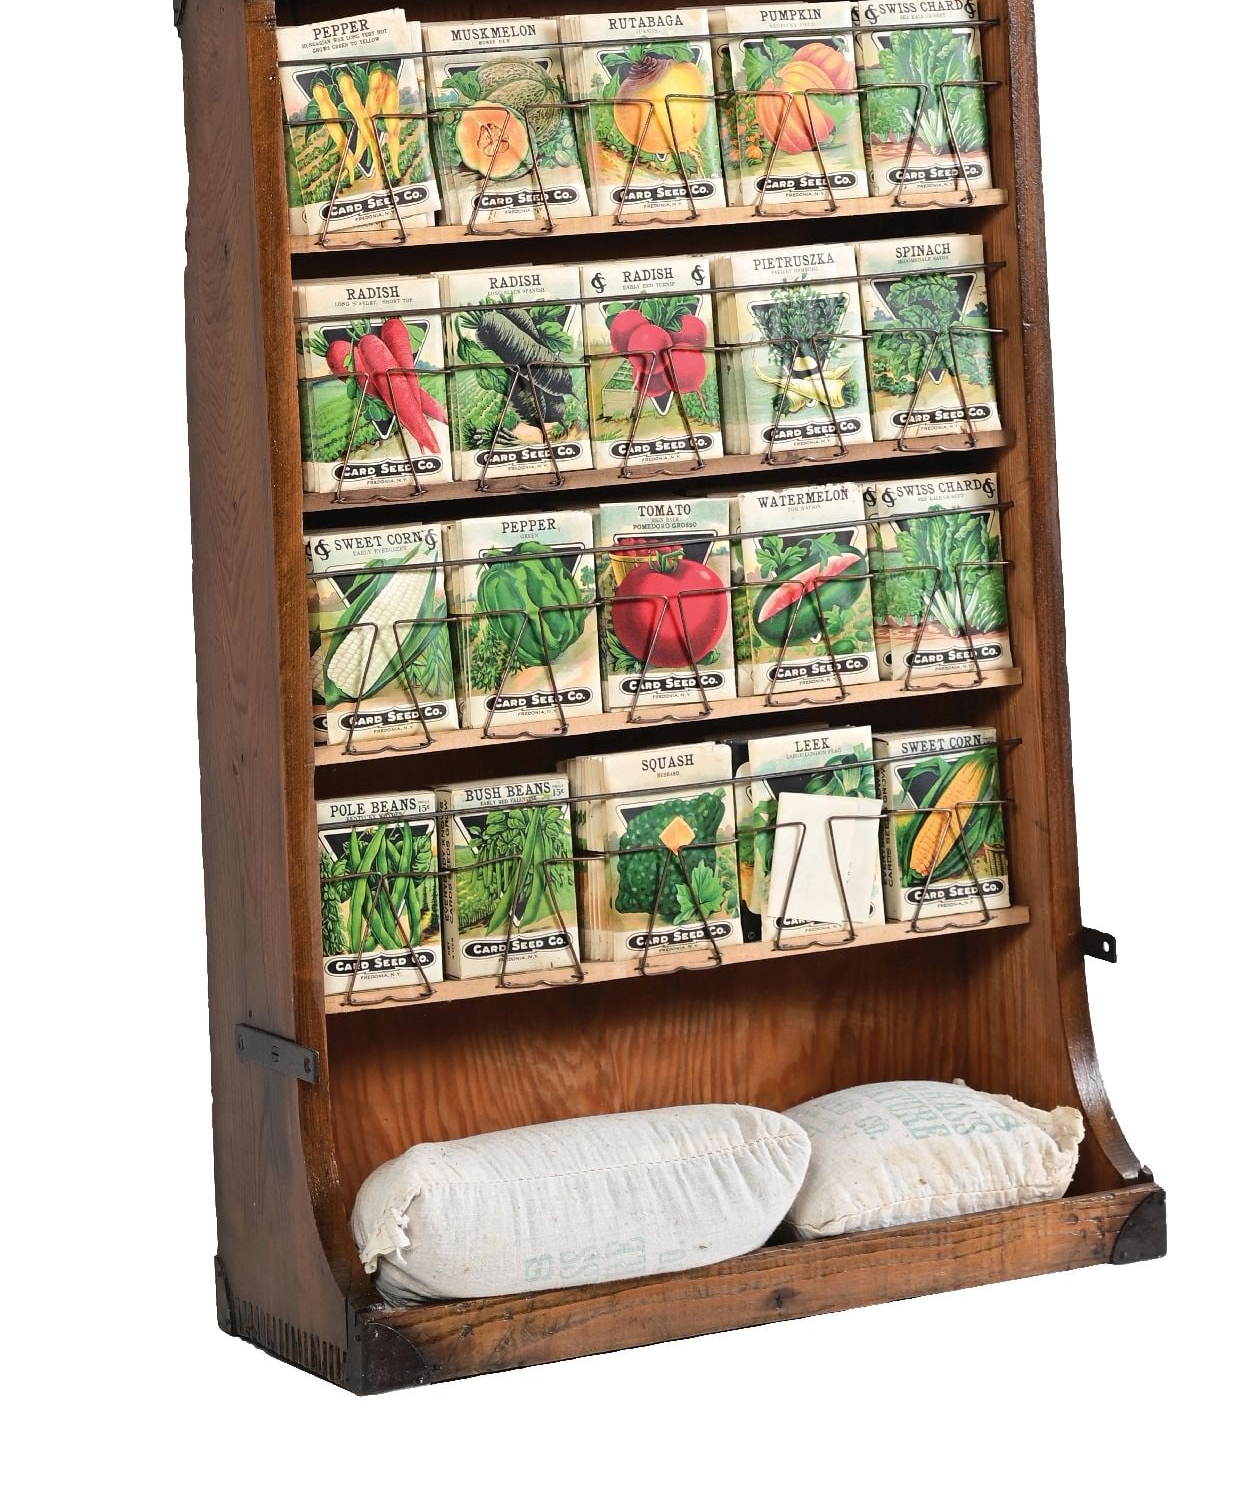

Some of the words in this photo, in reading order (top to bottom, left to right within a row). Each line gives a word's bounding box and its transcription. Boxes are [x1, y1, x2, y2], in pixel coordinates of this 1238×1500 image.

[878, 2, 916, 15] SWISS
[920, 0, 963, 12] CHARD
[608, 14, 684, 30] RUTABAGA
[760, 8, 822, 22] PUMPKIN
[312, 18, 370, 40] PEPPER
[451, 24, 536, 42] MUSKMELON
[833, 173, 851, 184] CO.
[931, 166, 962, 178] SEED
[403, 190, 423, 202] CO.
[553, 190, 572, 200] CO.
[656, 188, 689, 199] SEED
[690, 185, 709, 196] CO.
[895, 243, 952, 259] SPINACH
[753, 253, 835, 271] PIETRUSZKA
[622, 268, 673, 282] RADISH
[488, 275, 542, 290] RADISH
[345, 286, 400, 300] RADISH
[934, 410, 966, 421] SEED
[968, 408, 986, 419] CO.
[806, 425, 836, 435] SEED
[839, 422, 857, 433] CO.
[556, 446, 576, 457] CO.
[655, 440, 685, 450] SEED
[417, 460, 436, 471] CO.
[896, 484, 935, 497] SWISS
[938, 480, 981, 493] CHARD
[757, 488, 849, 509] WATERMELON
[638, 504, 691, 516] TOMATO
[501, 518, 556, 535] PEPPER
[334, 537, 384, 551] SWEET
[386, 532, 421, 545] CORN
[981, 648, 998, 658] CO.
[845, 660, 864, 670] CO.
[665, 678, 697, 689] SEED
[700, 675, 718, 686] CO.
[567, 690, 585, 701] CO.
[387, 710, 420, 722] SEED
[423, 706, 443, 717] CO.
[794, 737, 830, 753] LEEK
[901, 739, 946, 754] SWEET
[949, 735, 983, 750] CORN
[641, 754, 695, 772] SQUASH
[464, 786, 504, 802] BUSH
[507, 782, 551, 797] BEANS
[330, 803, 367, 818] POLE
[370, 799, 417, 814] BEANS
[981, 884, 999, 894] CO.
[511, 940, 544, 951] SEED
[547, 936, 566, 947] CO.
[672, 931, 705, 943] SEED
[374, 956, 407, 969] SEED
